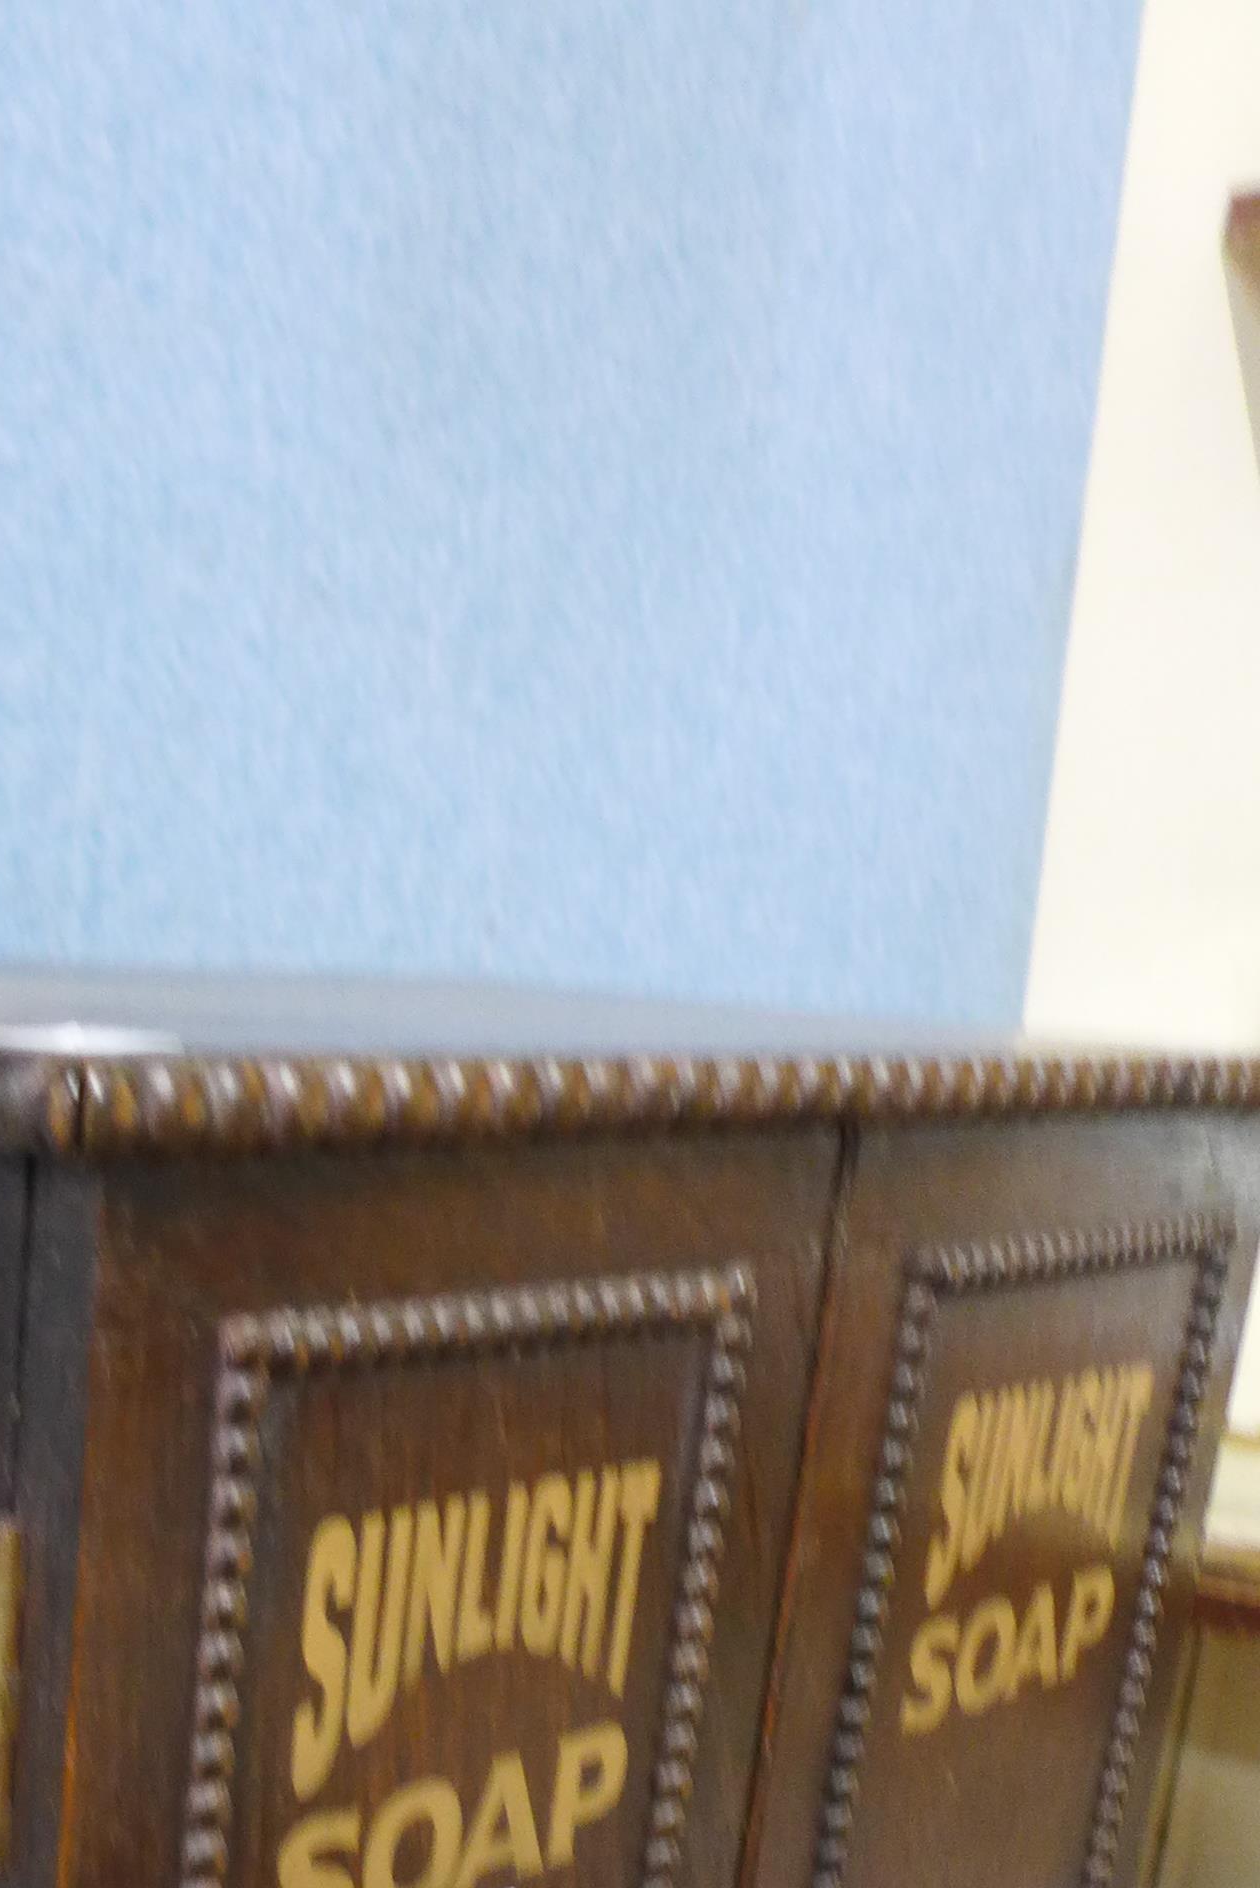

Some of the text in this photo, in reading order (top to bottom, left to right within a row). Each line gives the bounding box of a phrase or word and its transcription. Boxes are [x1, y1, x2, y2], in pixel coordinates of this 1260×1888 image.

[925, 1362, 1153, 1612] SUNLIGHT
[292, 1458, 660, 1800] SUNLIGHT
[900, 1565, 1115, 1735] SOAP
